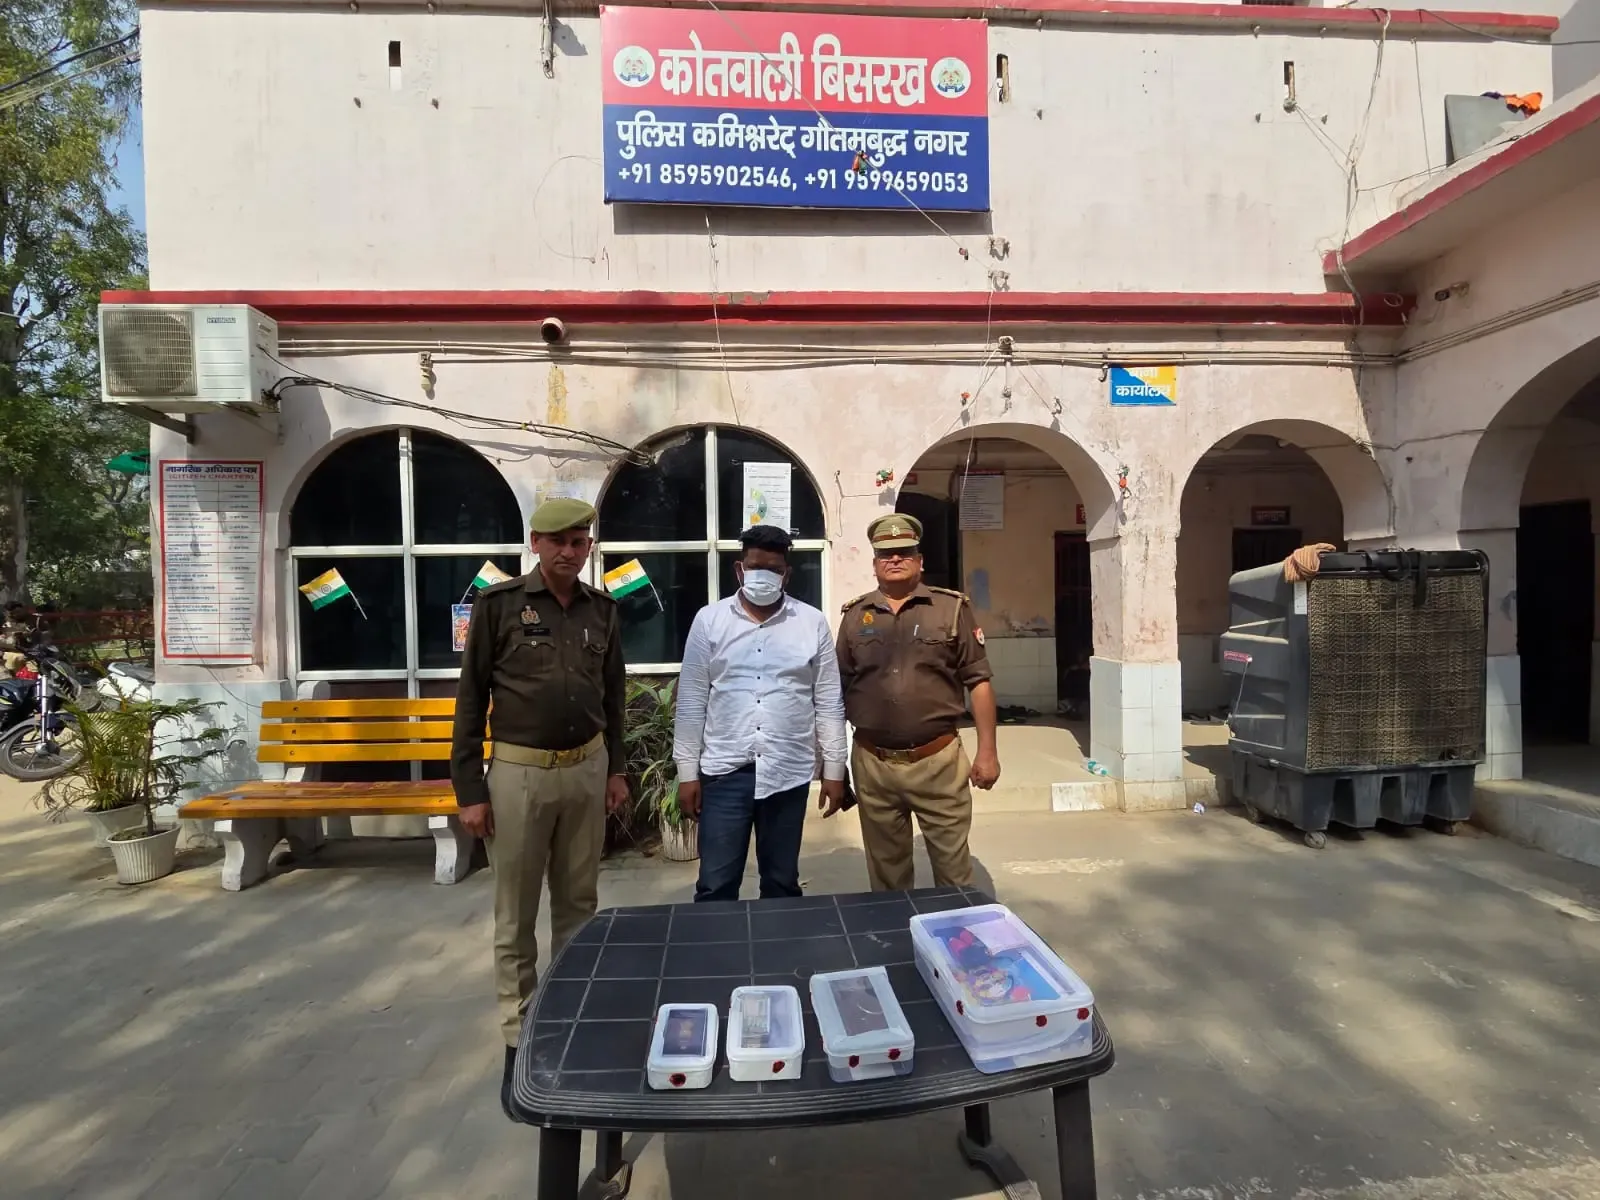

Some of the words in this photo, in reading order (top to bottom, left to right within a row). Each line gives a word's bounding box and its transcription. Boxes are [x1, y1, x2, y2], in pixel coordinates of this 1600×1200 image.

[658, 31, 803, 101] कोतवाली
[812, 34, 927, 107] बिसरख
[616, 110, 686, 160] पुलिस
[800, 117, 909, 167] गौतमबुद्ध
[914, 129, 969, 156] नगर
[619, 163, 651, 184] +91
[660, 164, 797, 191] 8595902546,
[805, 169, 836, 189] +91
[844, 170, 969, 193] 9599659053
